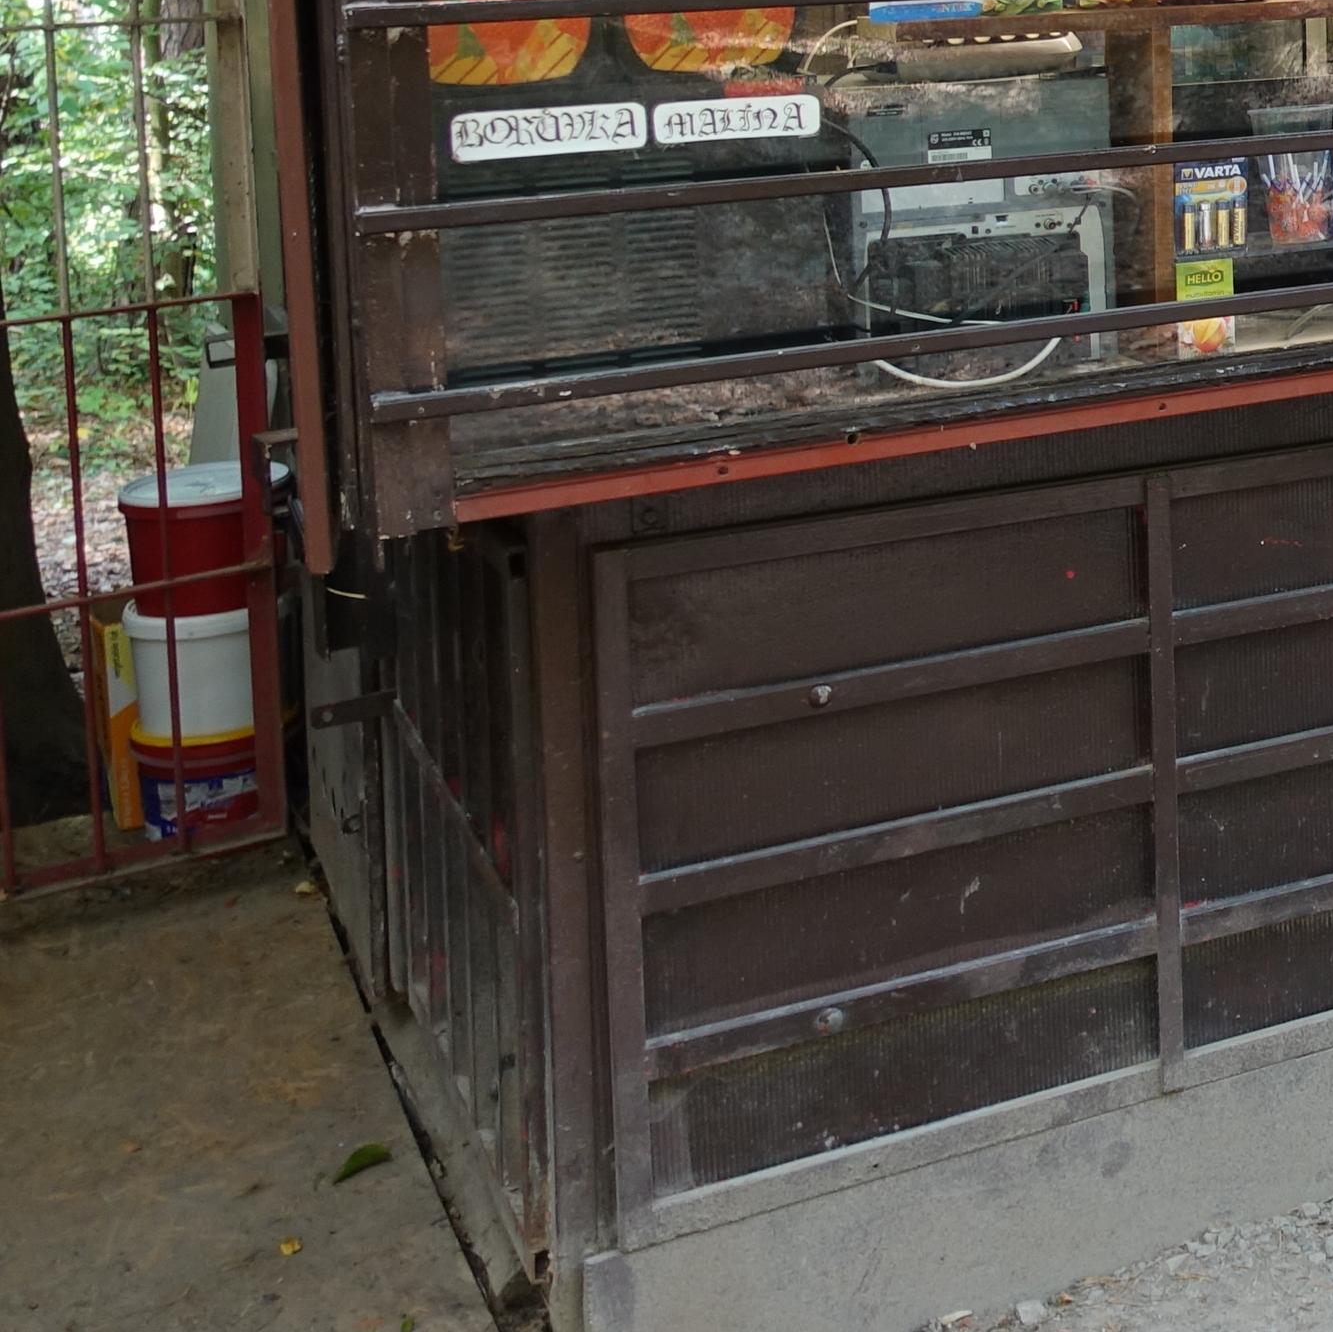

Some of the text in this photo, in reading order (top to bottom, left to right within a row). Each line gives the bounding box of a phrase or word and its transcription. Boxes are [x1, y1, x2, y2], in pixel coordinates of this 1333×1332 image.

[454, 108, 639, 149] BORŮVKA
[1194, 164, 1242, 179] VARTA
[1187, 271, 1222, 285] HELLO
